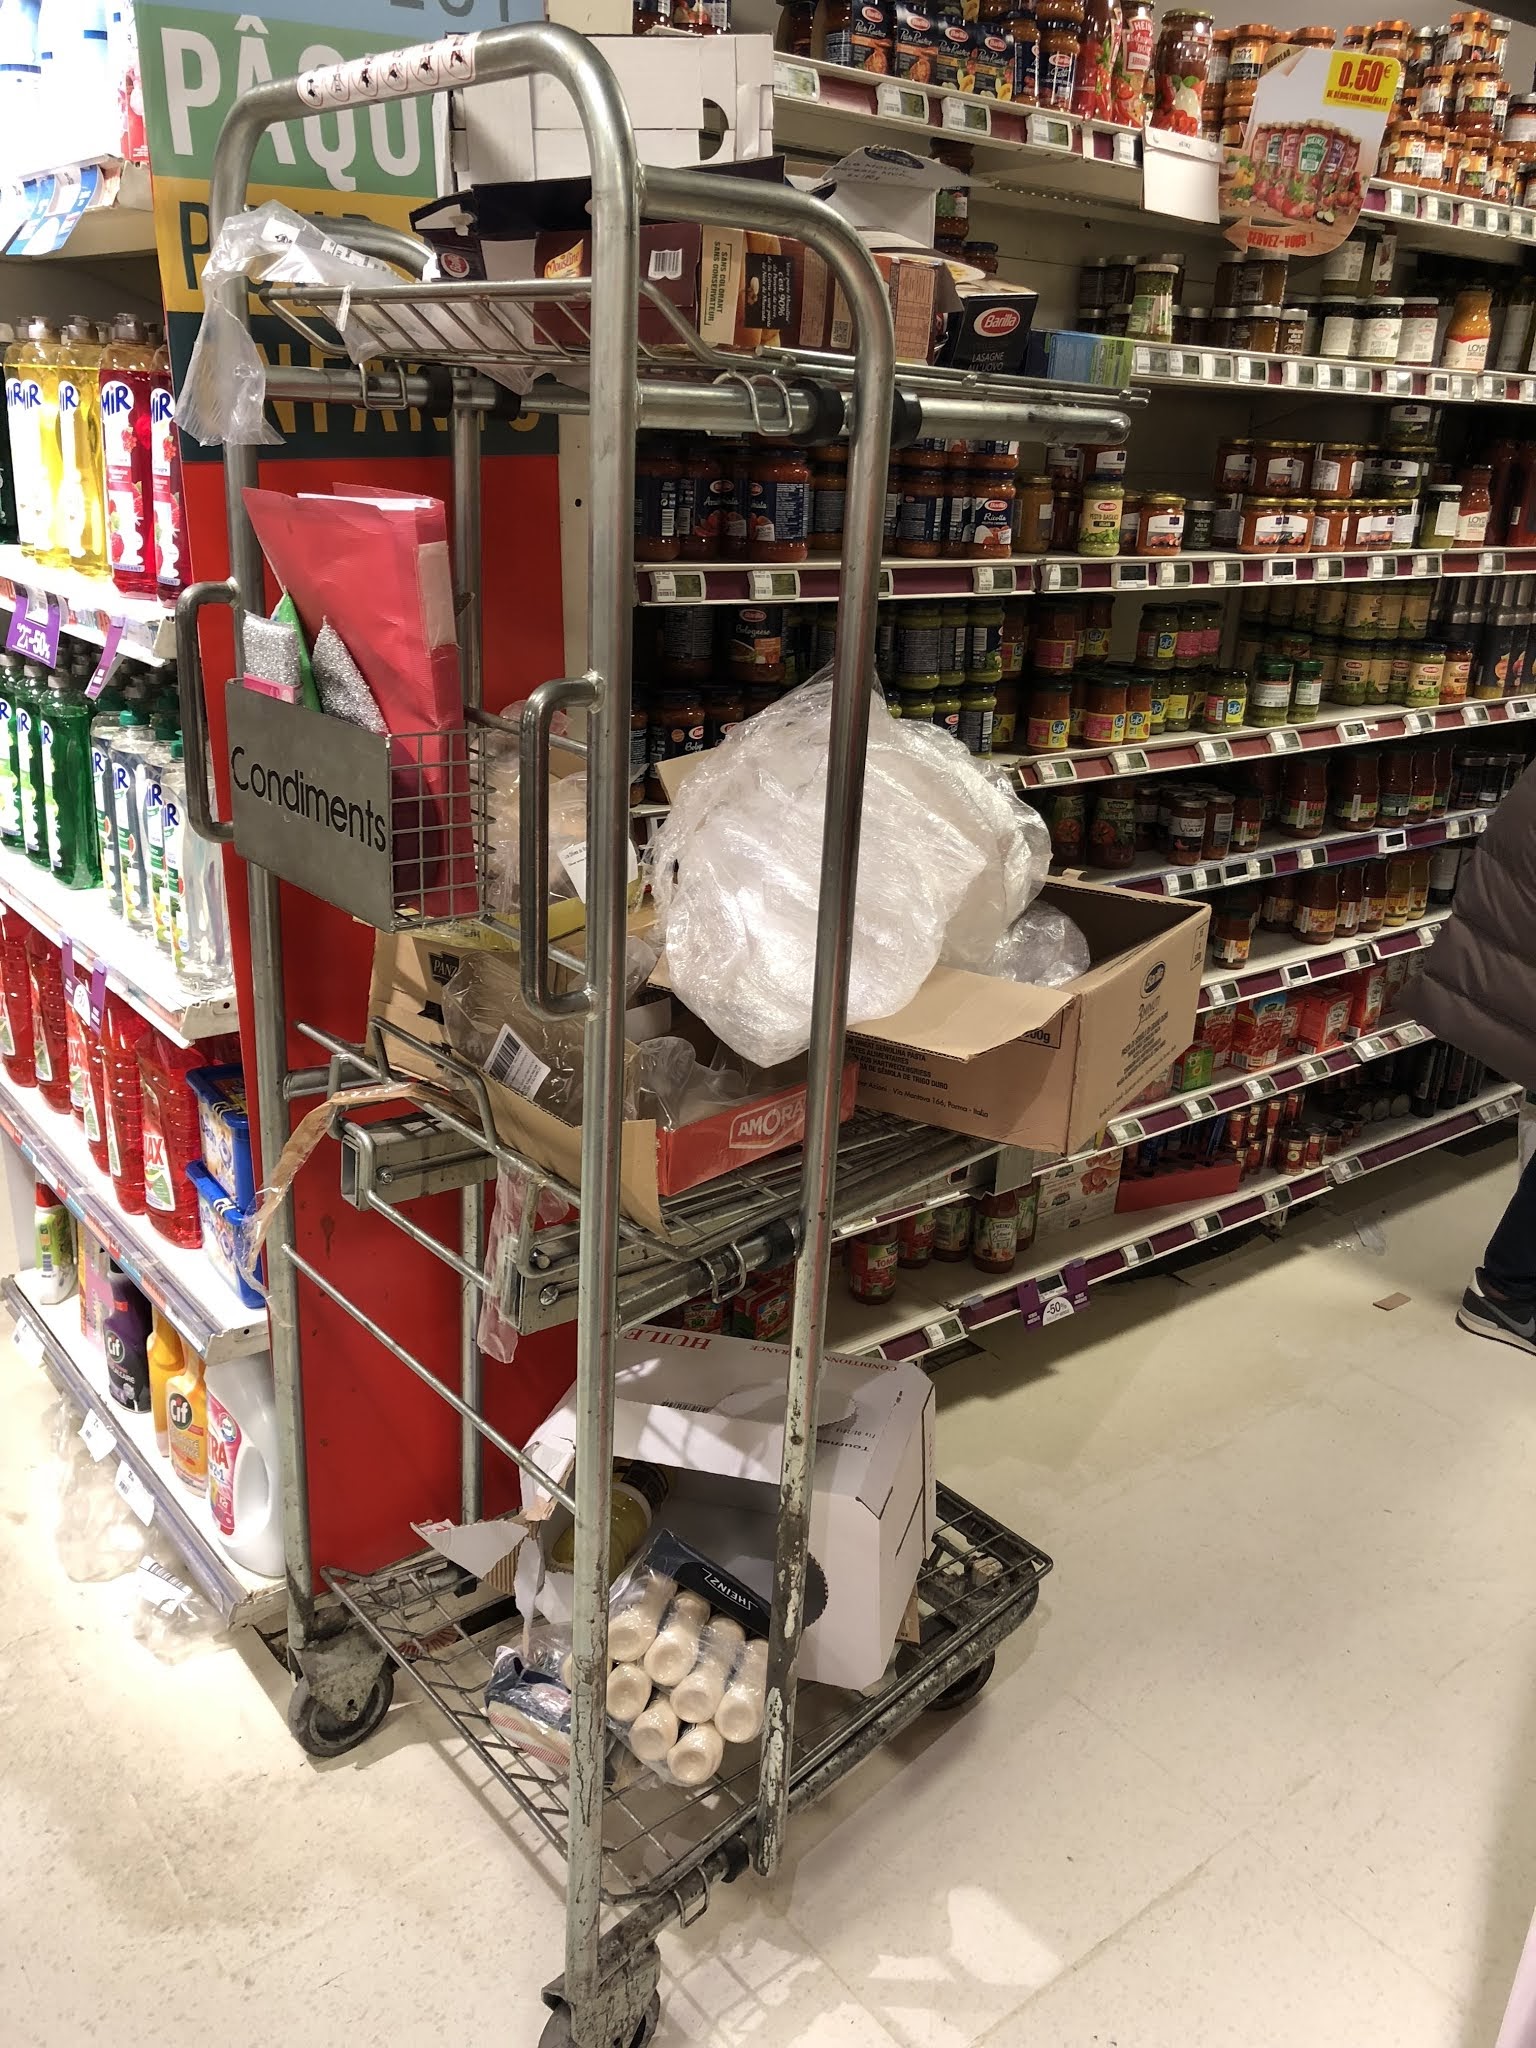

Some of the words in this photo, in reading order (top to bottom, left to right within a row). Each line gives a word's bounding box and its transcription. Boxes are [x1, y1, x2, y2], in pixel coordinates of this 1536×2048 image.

[1246, 231, 1307, 249] SERVEZ-VOUS
[712, 241, 721, 261] SANS
[720, 251, 728, 272] SANS
[708, 264, 719, 322] CONSERVATEUR
[716, 274, 726, 313] COLORANT
[983, 314, 1017, 329] Barilla
[972, 351, 1005, 363] LASAGNE
[231, 746, 386, 852] Condiments
[866, 1048, 909, 1065] ALIMENTAIRES
[907, 1050, 926, 1062] PASTA
[902, 1072, 911, 1081] DE
[912, 1074, 930, 1086] TRIGO
[931, 1080, 948, 1090] DURO
[892, 1087, 903, 1096] Via
[904, 1090, 931, 1103] Mantova
[931, 1097, 946, 1108] 166,
[947, 1101, 968, 1112] Parma
[972, 1108, 989, 1118] Italia
[737, 1101, 805, 1137] AMORA
[1046, 1301, 1068, 1315] -50%
[107, 1335, 122, 1357] Cif
[625, 1329, 711, 1351] HUILE
[169, 1397, 188, 1425] Cif
[709, 1576, 747, 1606] HEINZ
